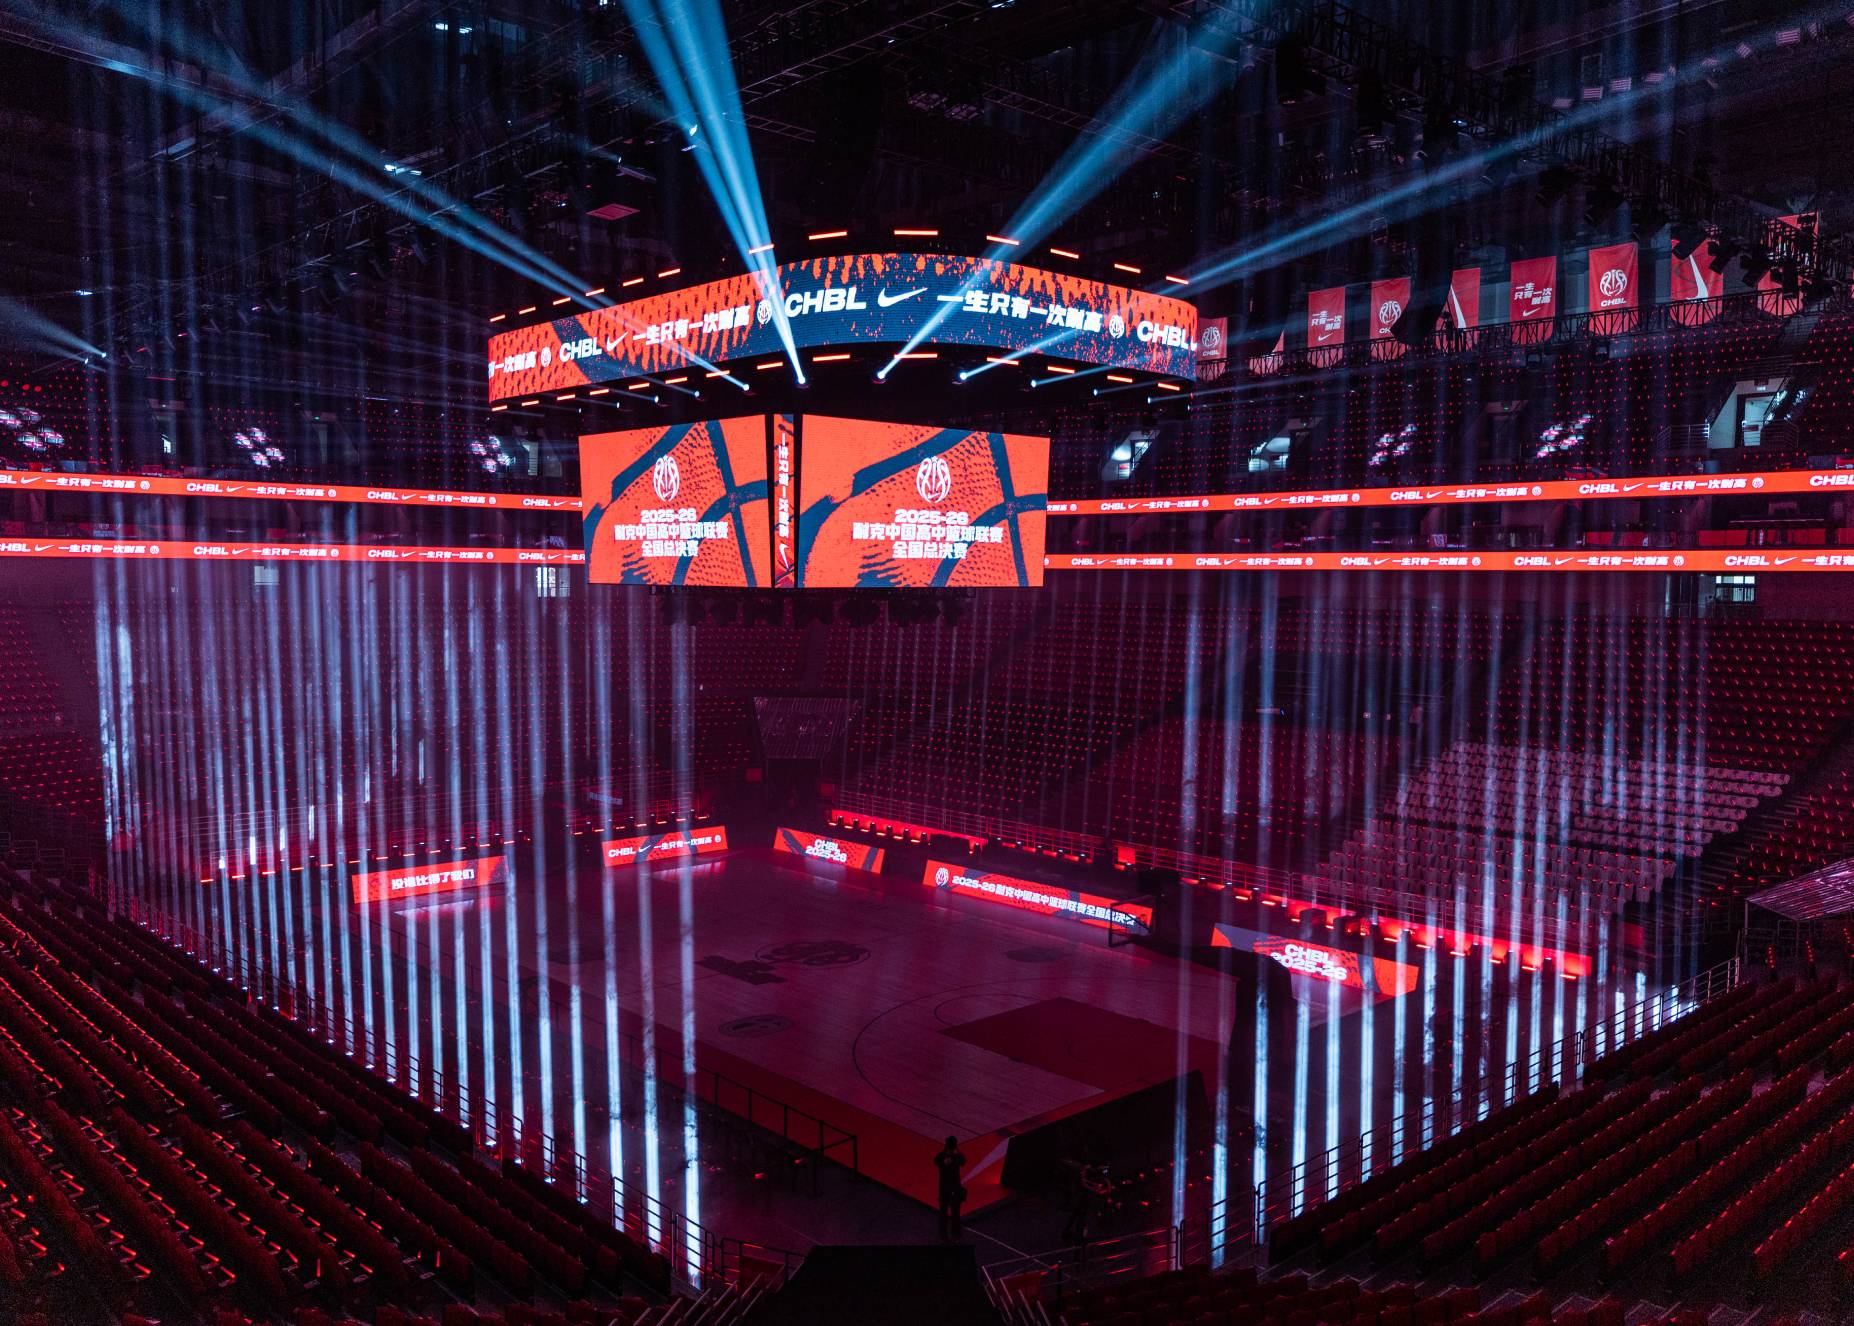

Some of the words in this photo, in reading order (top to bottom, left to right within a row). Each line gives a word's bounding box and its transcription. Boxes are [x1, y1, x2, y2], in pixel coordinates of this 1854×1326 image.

[1515, 282, 1535, 291] 一生
[1601, 298, 1627, 307] CHBL
[784, 287, 867, 318] CHBL
[936, 290, 1103, 333] 一生只有一次耐高
[559, 336, 603, 362] CHBL
[632, 305, 751, 345] 一生只有一次耐高
[1136, 320, 1189, 350] CHBL
[45, 477, 136, 489] 一生只有一次耐高
[778, 433, 789, 539] 一生只有一次耐高
[1578, 484, 1620, 495] CHBL
[1647, 478, 1748, 491] 一生只有一次耐高
[186, 482, 224, 493] CHBL
[246, 486, 325, 497] 一生只有一次耐高
[367, 490, 399, 501] CHBL
[1390, 490, 1424, 501] CHBL
[1446, 486, 1529, 499] 一生只有一次耐高
[522, 498, 551, 507] CHBL
[1100, 502, 1126, 511] CHBL
[1233, 497, 1262, 506] CHBL
[640, 508, 697, 523] 2025-26
[894, 509, 969, 524] 2025-26
[852, 522, 1004, 543] 耐克中国高中篮球联赛
[0, 542, 31, 553] HBL
[58, 543, 147, 554] 一生只有一次耐高
[193, 545, 229, 556] CHBL
[251, 547, 328, 557] 一生只有一次耐高
[368, 549, 399, 558] CHBL
[641, 540, 699, 557] 全国总决赛
[892, 541, 968, 559] 全国总决赛
[518, 552, 546, 561] CHBL
[1071, 557, 1095, 566] CHBL
[1195, 557, 1222, 566] CHBL
[1340, 557, 1372, 566] CHBL
[1391, 556, 1469, 566] 一生只有一次耐高
[1513, 556, 1552, 566] CHBL
[1576, 555, 1669, 566] 一生只有一次耐高
[1724, 555, 1770, 566] CHBL
[814, 839, 840, 852] CHBL
[607, 846, 637, 858] CHBL
[1285, 943, 1334, 964] CHBL
